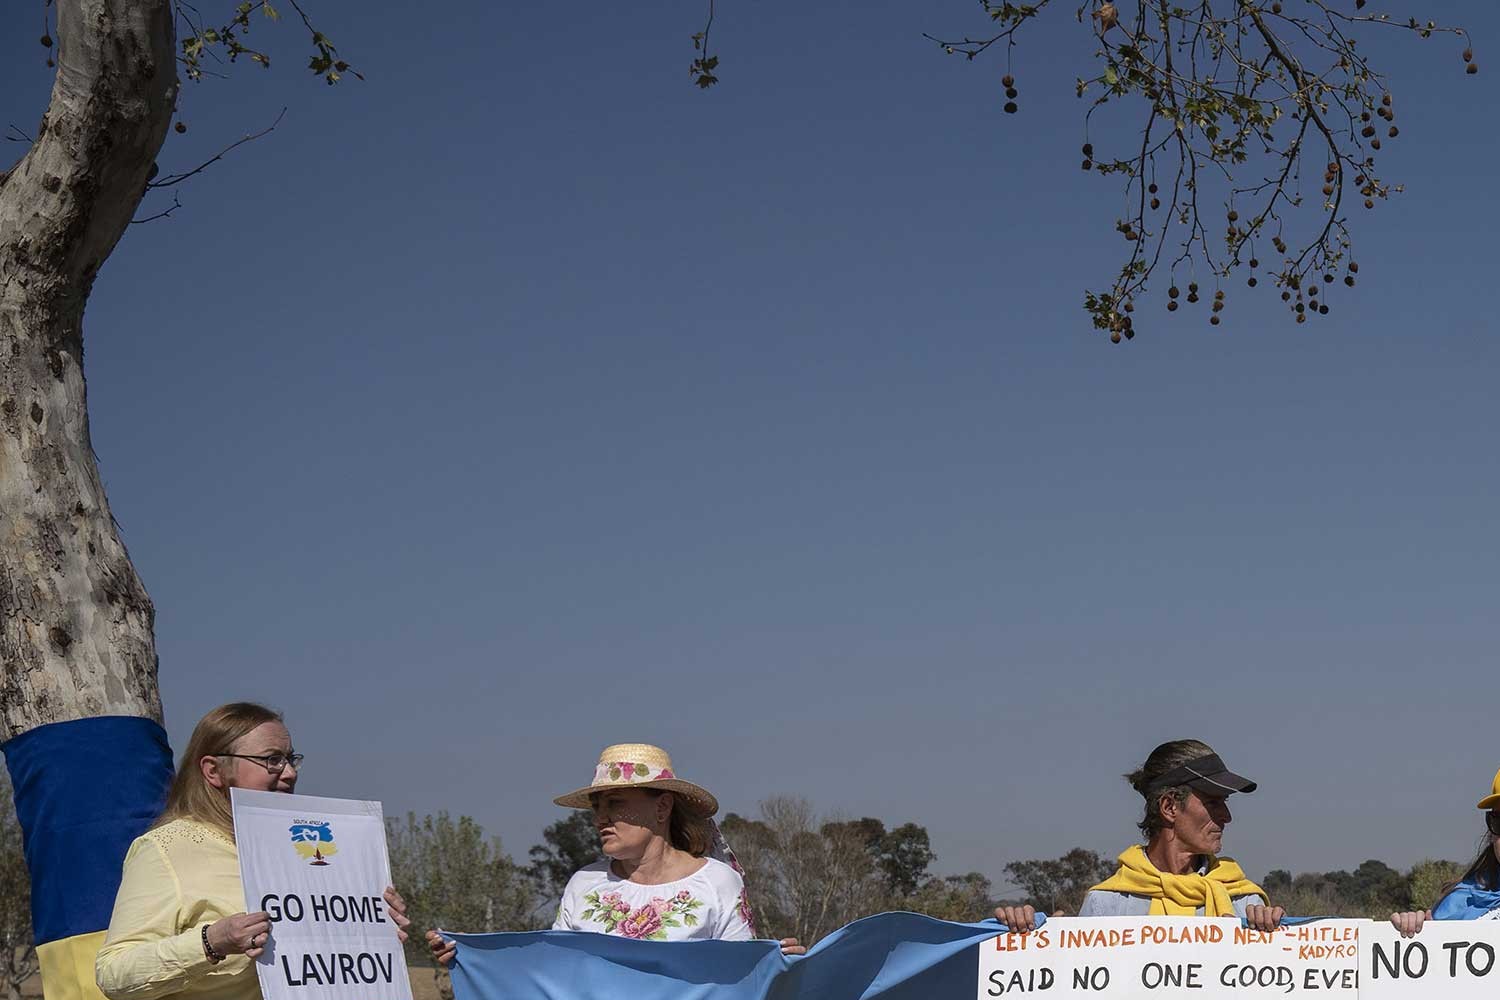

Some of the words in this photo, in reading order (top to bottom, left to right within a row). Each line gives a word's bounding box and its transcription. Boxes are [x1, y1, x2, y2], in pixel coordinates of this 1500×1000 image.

[261, 893, 304, 923] GO
[311, 893, 386, 924] HOME
[996, 929, 1051, 952] LET'S
[1059, 928, 1136, 949] INVADE
[1140, 924, 1224, 946] POLAND
[280, 952, 393, 987] LAVROV
[1371, 939, 1429, 979] NO
[1442, 940, 1496, 978] TO
[987, 968, 1055, 997] SAID
[1072, 966, 1110, 991] NO
[1141, 962, 1203, 989] ONE
[1220, 964, 1294, 994] GOOD,
[1303, 967, 1359, 990] EVE
